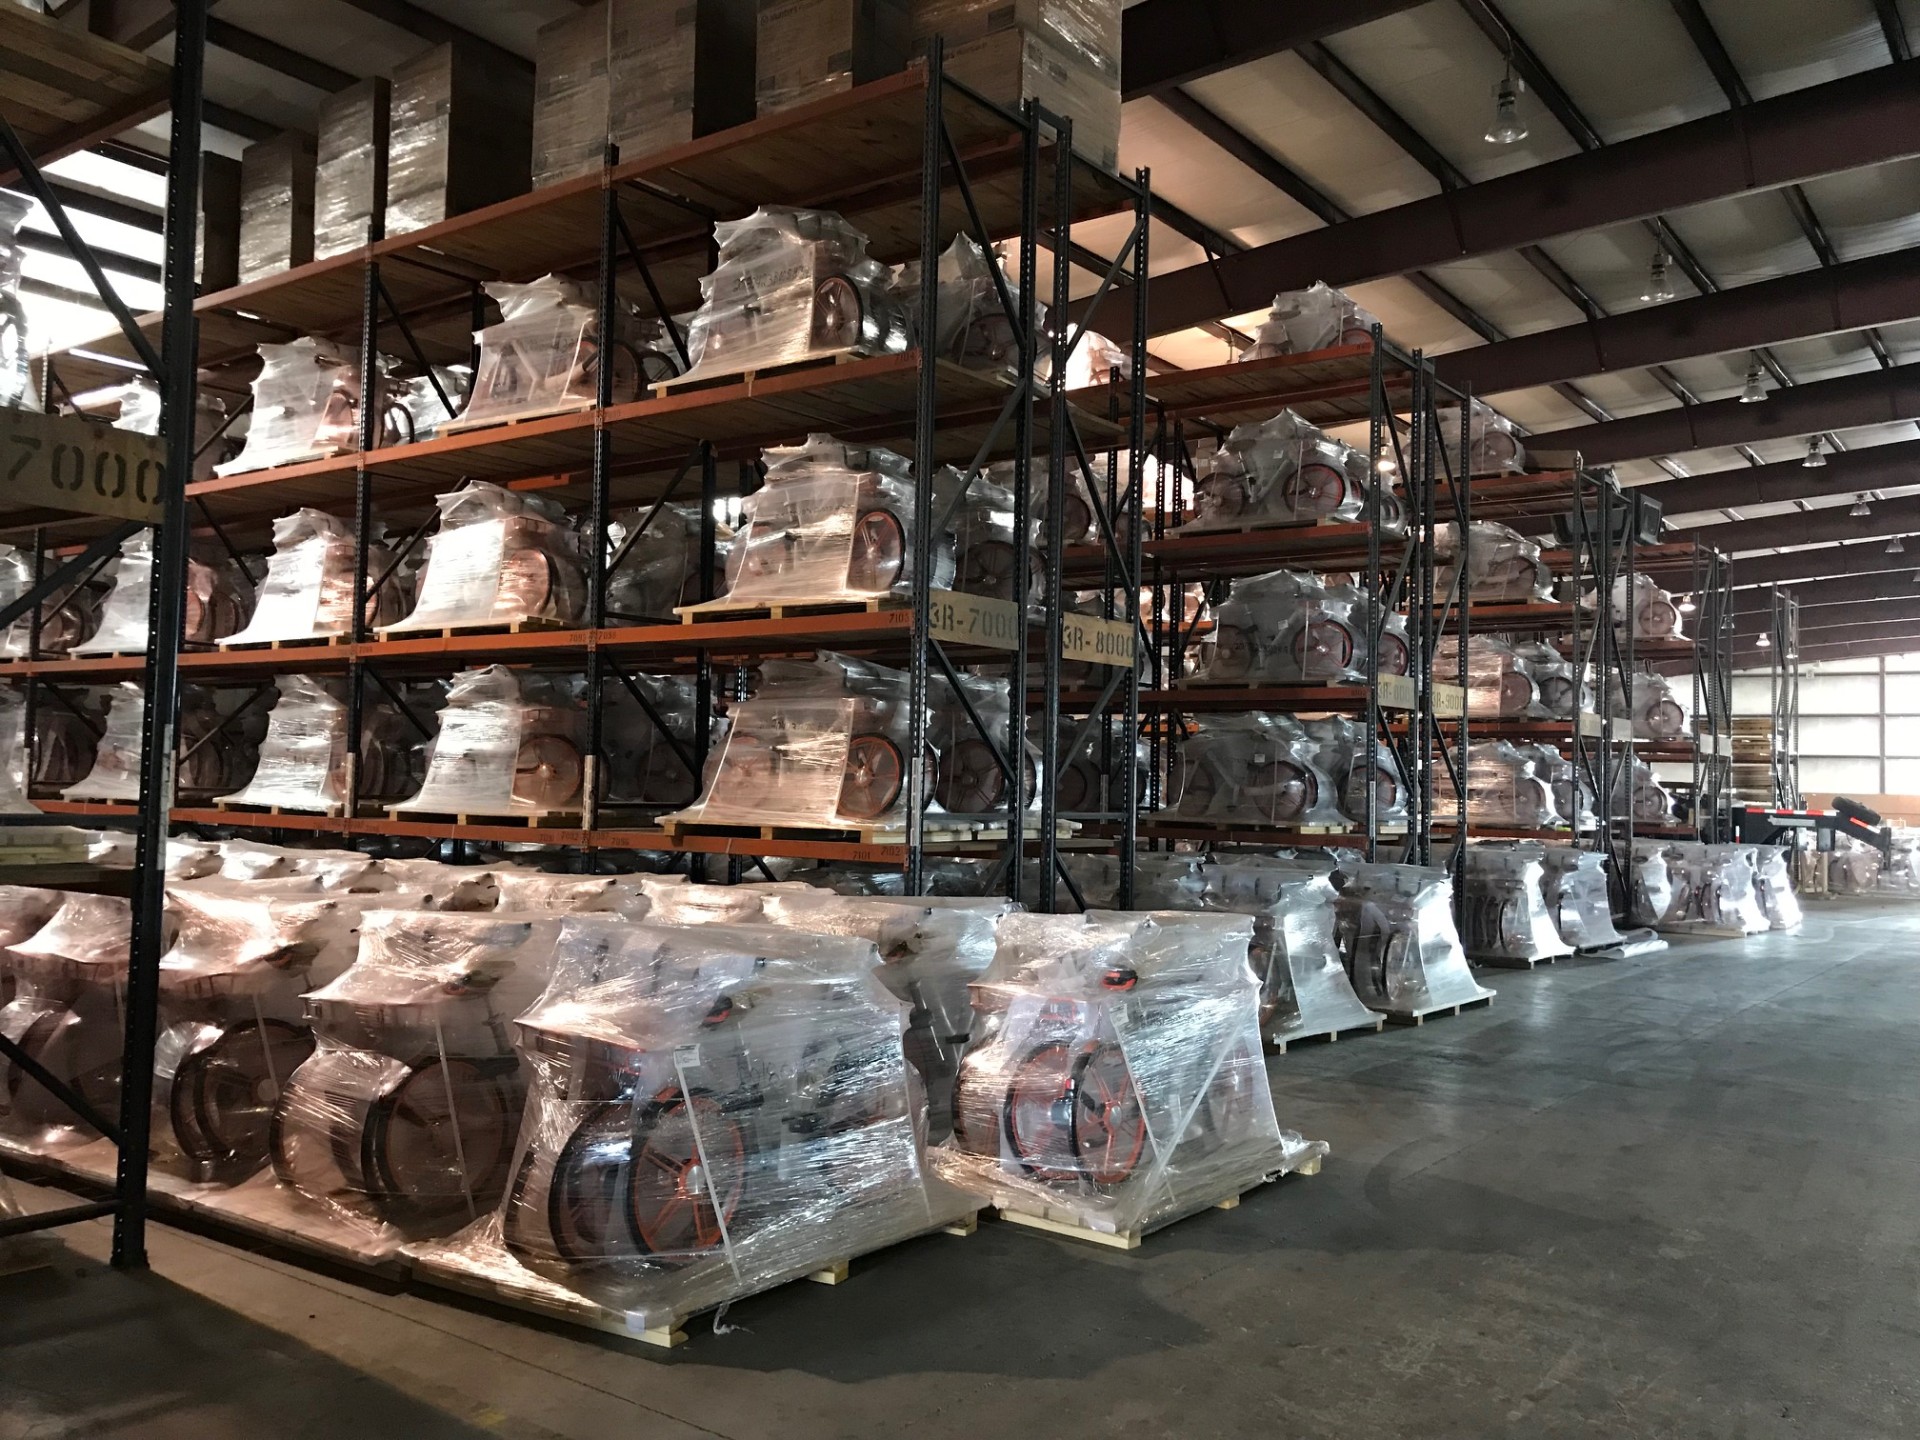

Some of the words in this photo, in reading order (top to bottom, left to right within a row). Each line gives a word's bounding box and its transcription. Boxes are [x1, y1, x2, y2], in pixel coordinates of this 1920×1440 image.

[8, 435, 166, 504] 7000
[930, 602, 1017, 640] 3R-7000
[1063, 625, 1133, 658] 3R-8000
